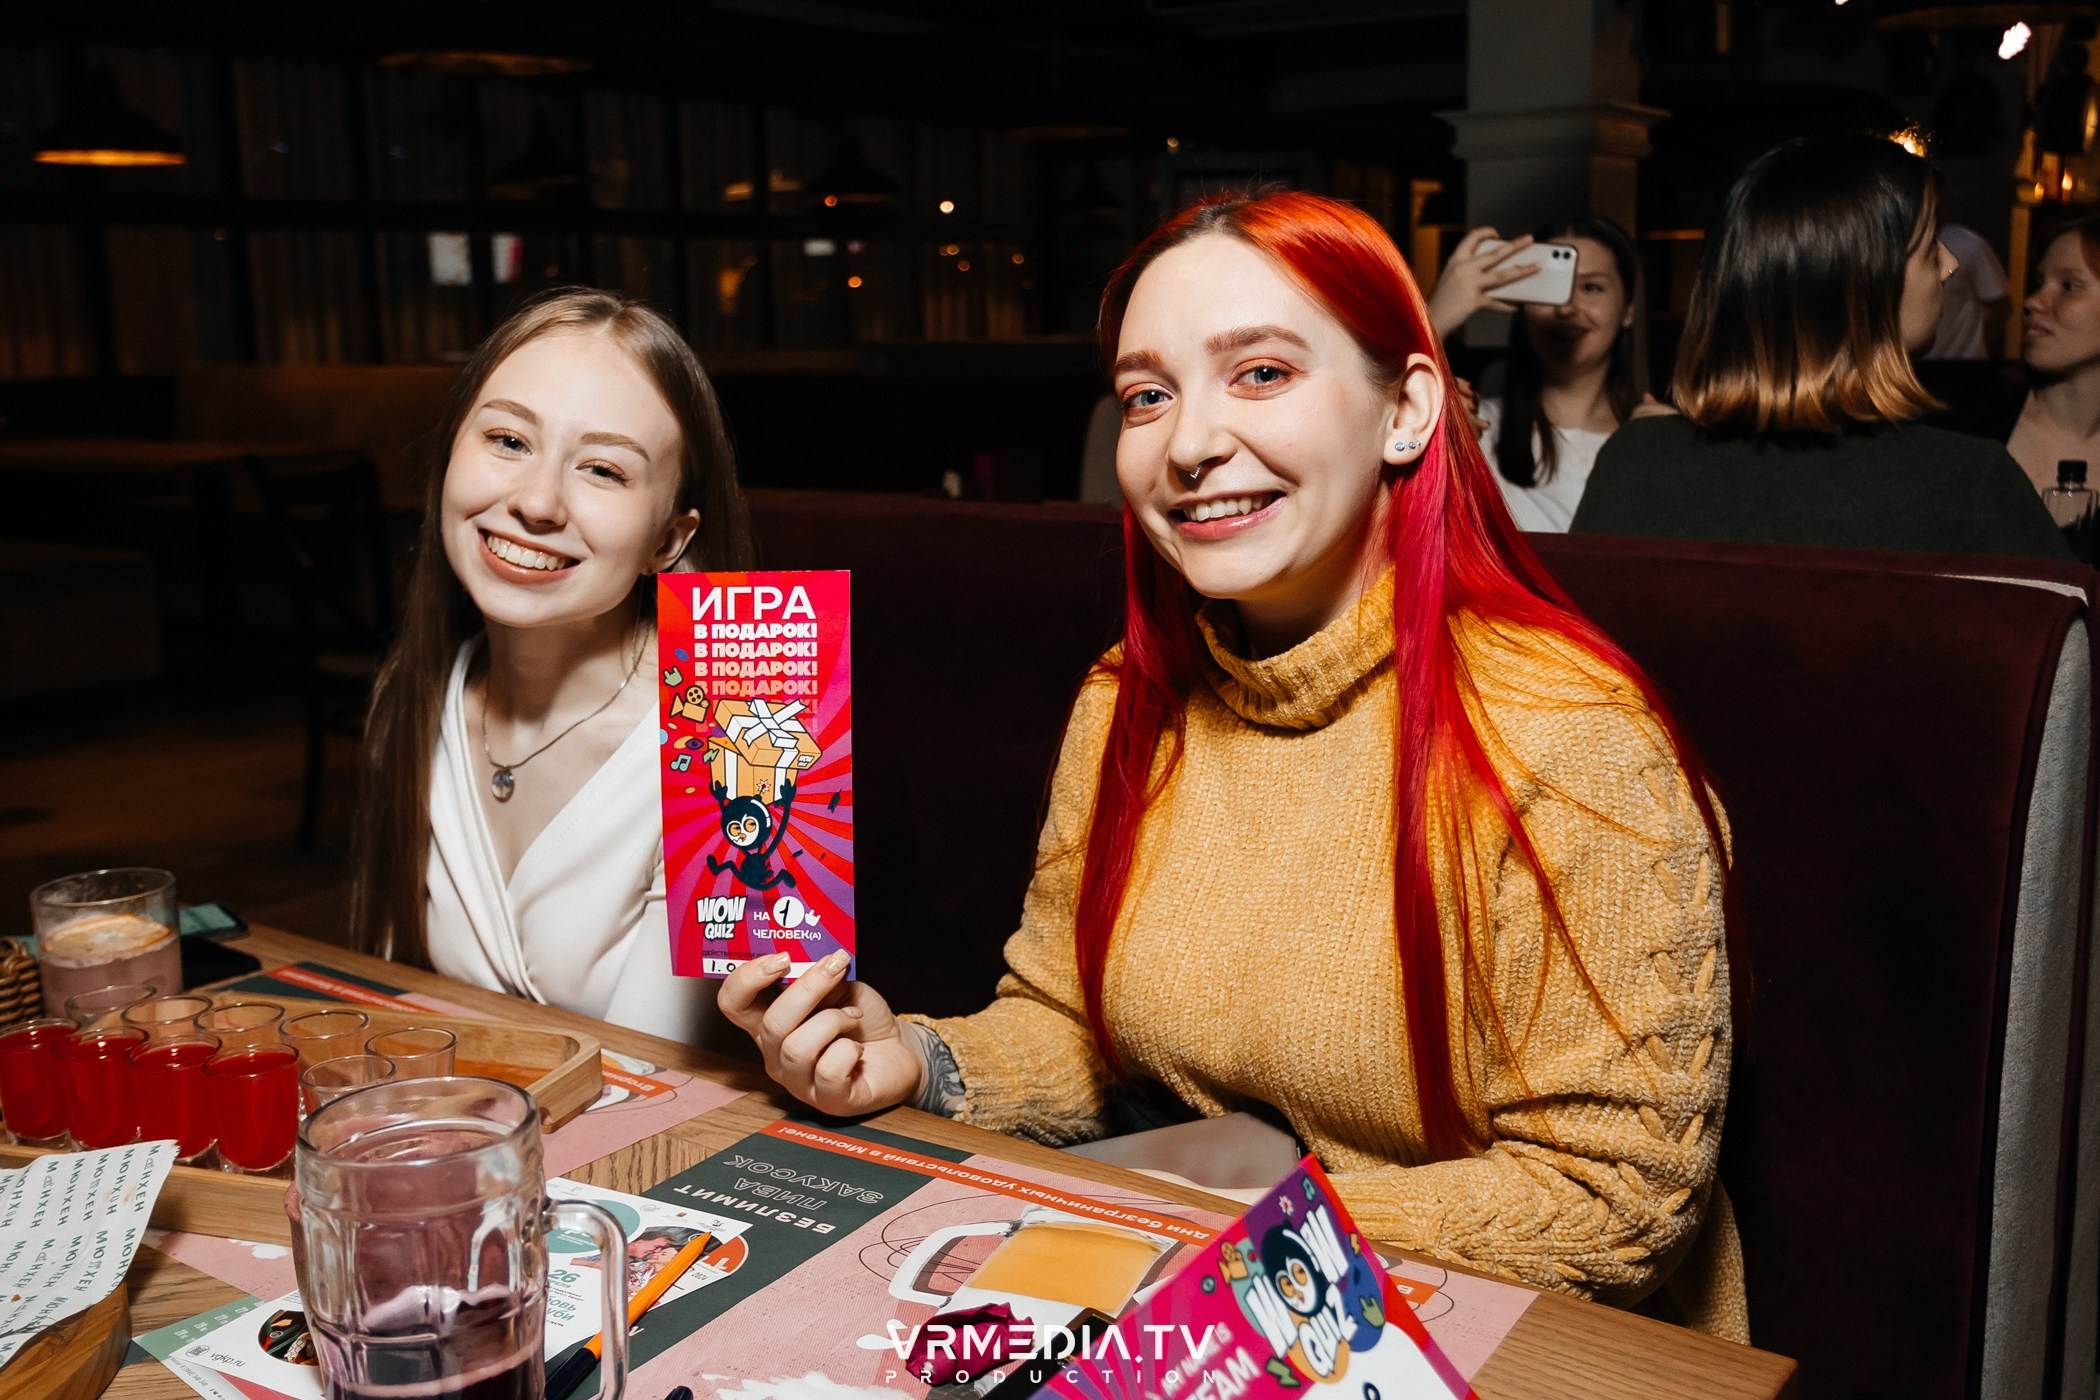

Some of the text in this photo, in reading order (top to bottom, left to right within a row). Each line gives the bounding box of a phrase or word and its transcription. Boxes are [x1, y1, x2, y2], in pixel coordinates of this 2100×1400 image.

[692, 586, 817, 620] ИГРА
[694, 623, 818, 641] В ПОДАРОК!
[694, 642, 818, 659] В ПОДАРОК!
[695, 661, 818, 678] В ПОДАРОК!
[712, 680, 818, 697] ПОДАРОК!
[697, 896, 747, 923] WOW
[753, 911, 771, 921] НА
[704, 922, 735, 939] QUIZ
[753, 929, 822, 940] ЧЕЛОВЕК(А)
[777, 1126, 868, 1155] Мюнхене!
[722, 1154, 884, 1204] ЗАКУСОК
[882, 1153, 1018, 1190] удовольствий
[57, 1158, 85, 1227] МЮНХЕН
[733, 1177, 827, 1211] ПИВА
[673, 1184, 836, 1235] БЕЗЛИМИТ
[1018, 1186, 1163, 1229] безграничных
[548, 1269, 581, 1283] 26
[1298, 1282, 1359, 1378] QUIZ
